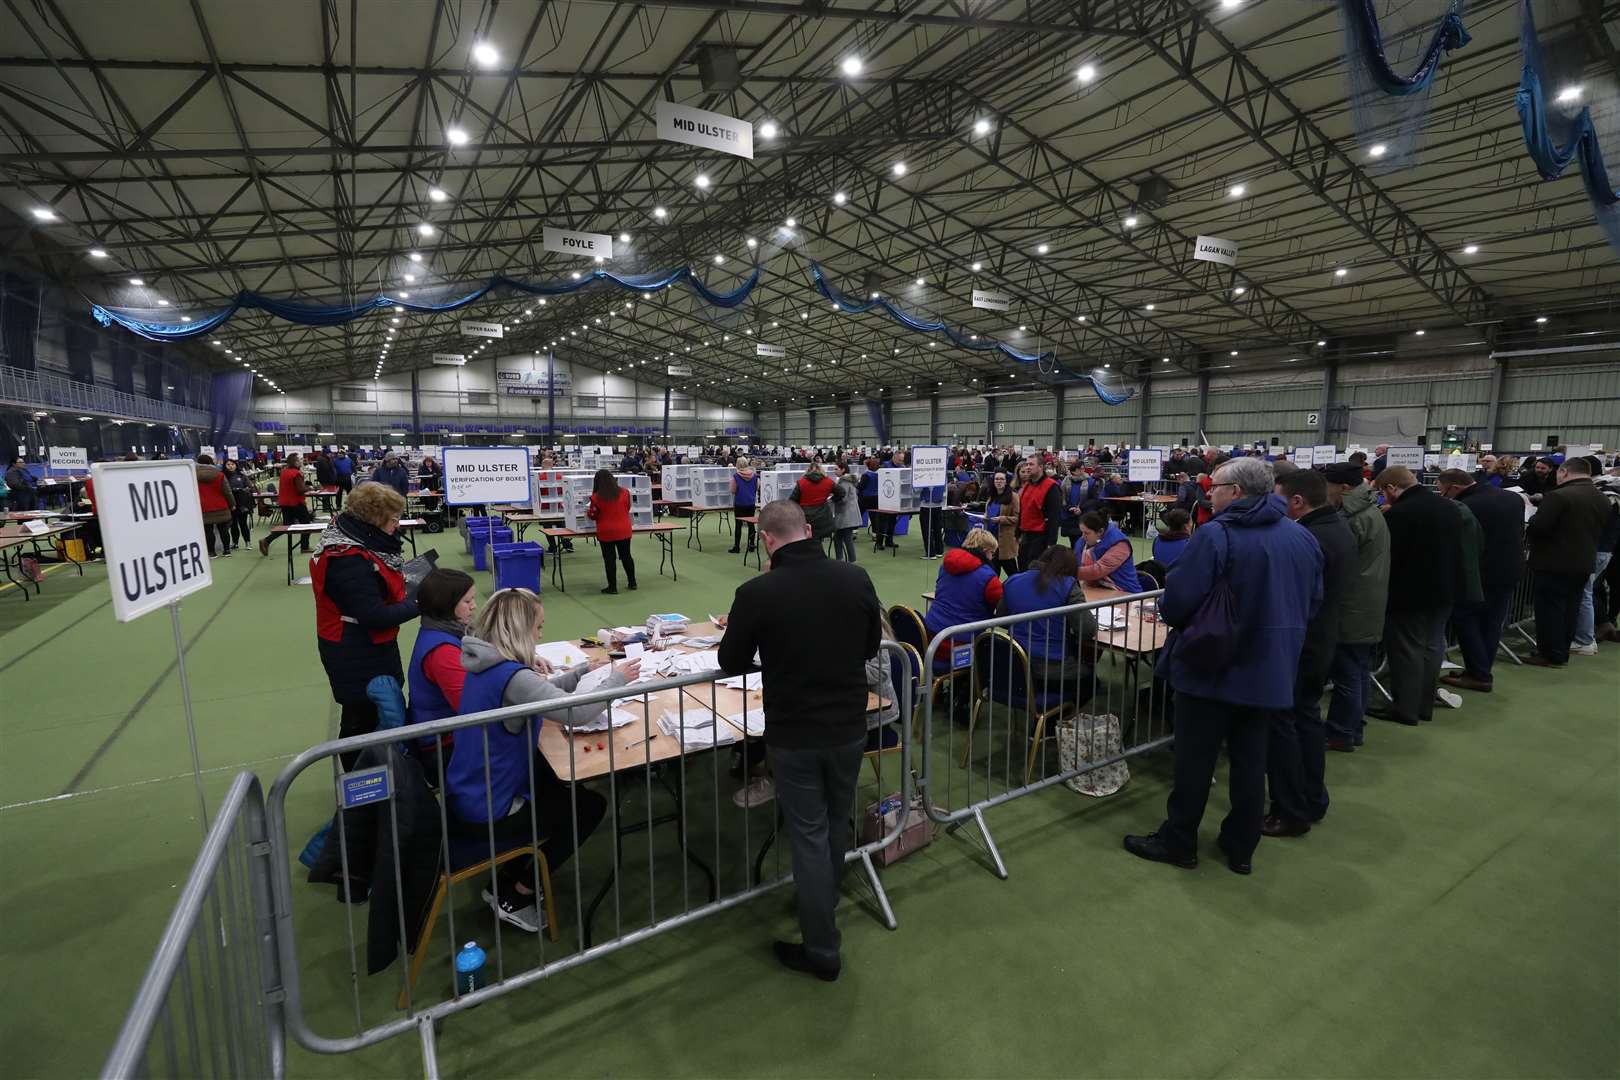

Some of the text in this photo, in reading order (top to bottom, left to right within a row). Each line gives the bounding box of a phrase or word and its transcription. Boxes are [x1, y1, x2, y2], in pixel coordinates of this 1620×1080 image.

[673, 117, 695, 132] MID
[562, 237, 594, 250] FOYLE
[1199, 244, 1221, 254] LAGAN
[1309, 414, 1317, 424] 2
[456, 464, 518, 472] MID ULSTER
[128, 479, 178, 522] MID
[120, 541, 204, 602] ULSTER
